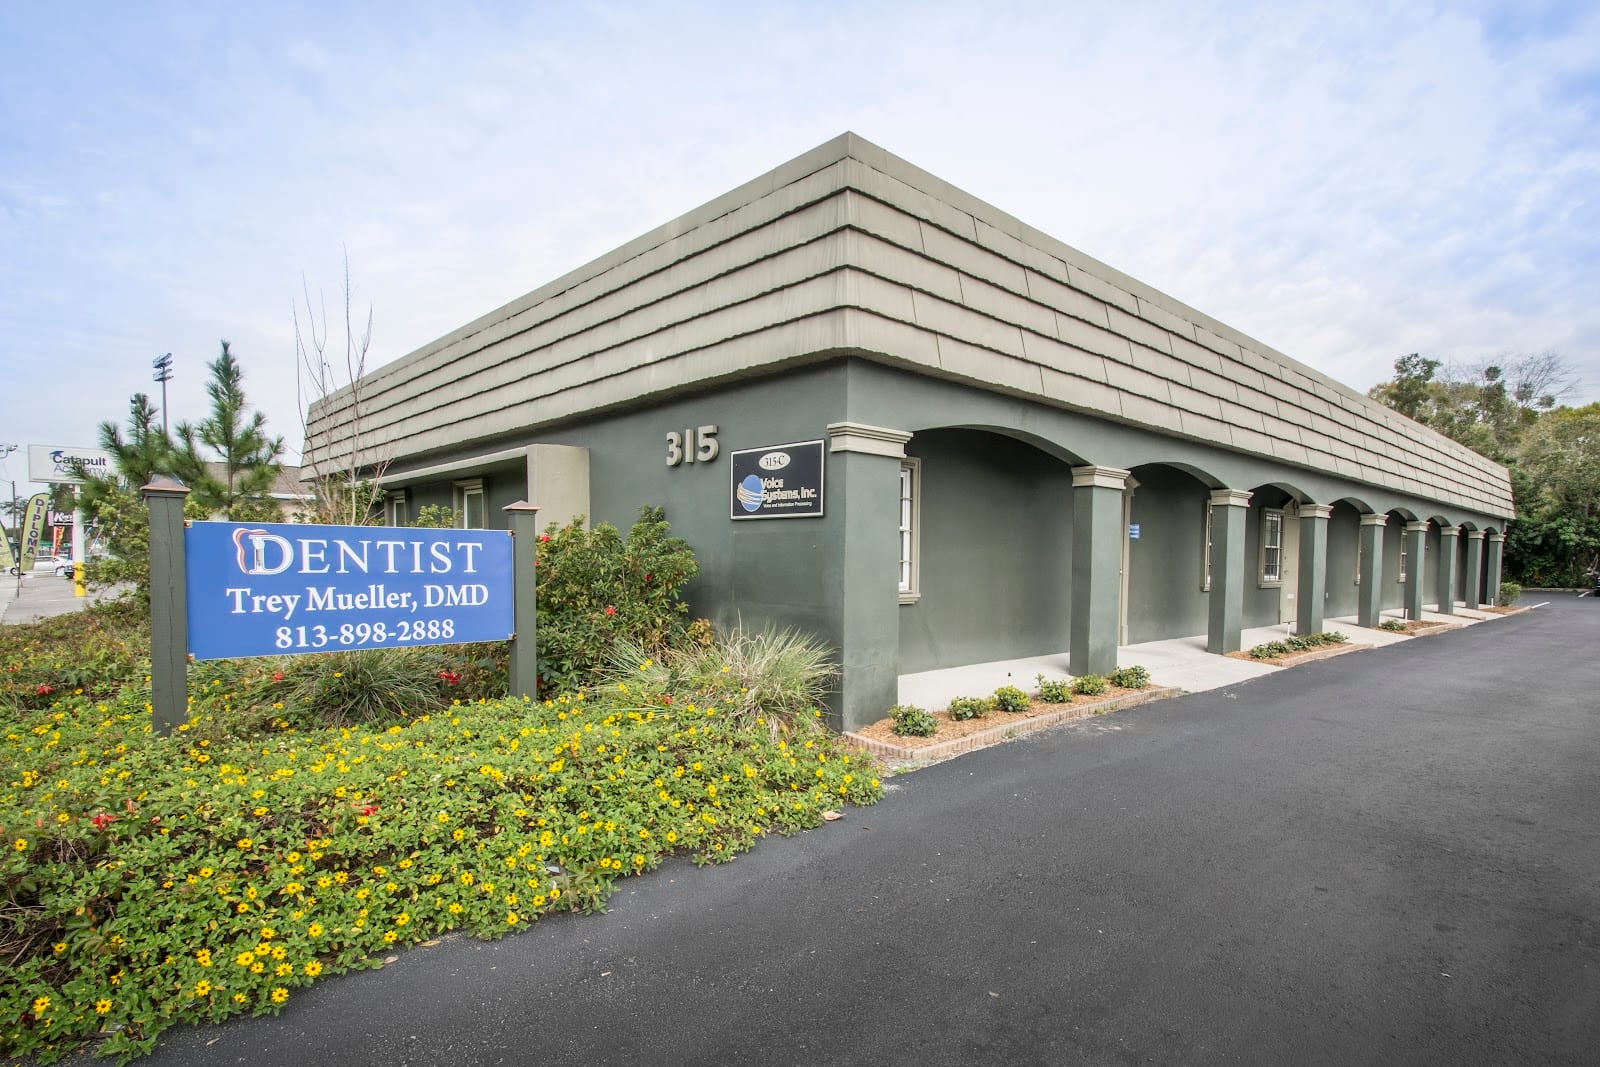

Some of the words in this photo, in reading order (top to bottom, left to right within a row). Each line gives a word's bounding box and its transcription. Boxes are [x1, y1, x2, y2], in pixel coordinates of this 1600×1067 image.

[666, 424, 719, 466] 315
[52, 454, 106, 467] Catapult
[53, 463, 106, 480] Acemy
[765, 455, 785, 467] 315-C
[760, 476, 784, 489] Voice
[761, 488, 801, 503] Systems,
[801, 486, 817, 499] Inc.
[27, 498, 45, 554] DIPLOMA
[248, 534, 483, 575] DENTIST
[226, 587, 301, 620] Trey
[305, 584, 418, 613] Mueller,
[424, 584, 489, 608] DMD
[275, 618, 455, 649] 813-898-2888
